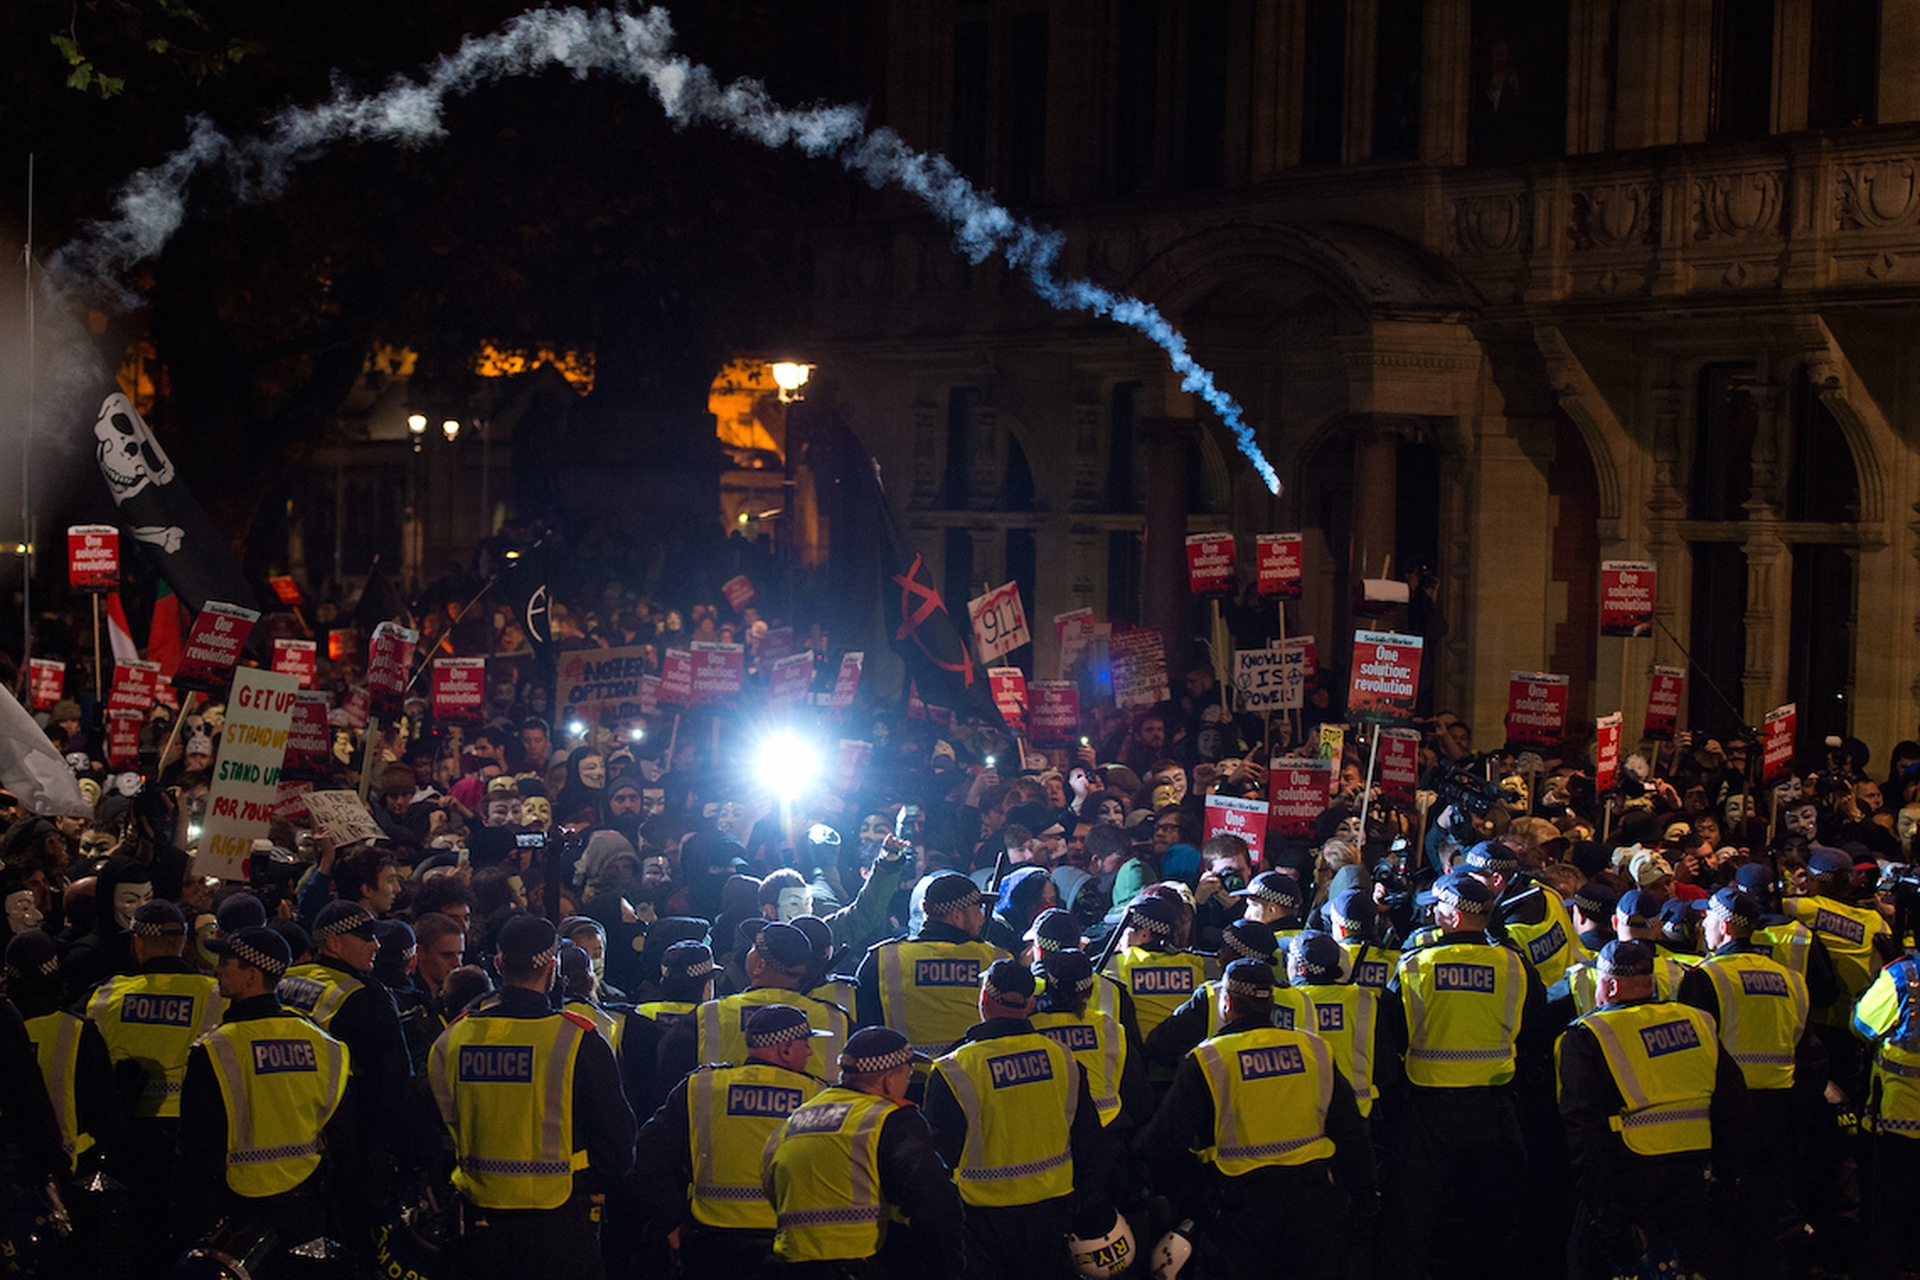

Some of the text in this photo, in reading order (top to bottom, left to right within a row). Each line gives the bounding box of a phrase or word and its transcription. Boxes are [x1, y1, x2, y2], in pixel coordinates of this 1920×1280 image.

[1619, 571, 1638, 584] One
[1604, 597, 1652, 611] revolution
[214, 616, 233, 632] One
[982, 598, 1023, 644] 911
[186, 646, 236, 665] revolution
[1376, 645, 1398, 662] One
[1256, 669, 1282, 688] IS
[1360, 660, 1411, 679] solution:
[1354, 677, 1413, 696] revolution
[1528, 683, 1548, 698] One
[239, 685, 297, 714] GET UP
[293, 707, 308, 718] ne
[1511, 712, 1561, 726] revolution
[287, 735, 327, 751] volution
[218, 761, 280, 786] STAND UP
[1290, 770, 1311, 786] One
[1277, 786, 1322, 802] solution:
[212, 796, 274, 823] FOR YOUR
[1225, 809, 1245, 826] One
[1272, 802, 1325, 817] revolution
[1817, 913, 1865, 942] POLICE
[1532, 928, 1567, 961] POLICE
[917, 961, 979, 984] POLICE
[1133, 971, 1191, 992] POLICE
[1358, 965, 1385, 984] ICE
[1437, 966, 1493, 990] POLICE
[1742, 972, 1787, 994] POLICE
[278, 978, 323, 1005] POLICE
[123, 997, 190, 1024] POLICE
[1642, 1023, 1698, 1054] POLICE
[255, 1043, 315, 1070] POLICE
[461, 1050, 530, 1077] POLICE
[1241, 1048, 1301, 1076] POLICE
[992, 1054, 1050, 1082] POLICE
[731, 1088, 798, 1113] POLICE
[792, 1107, 848, 1130] POLICE
